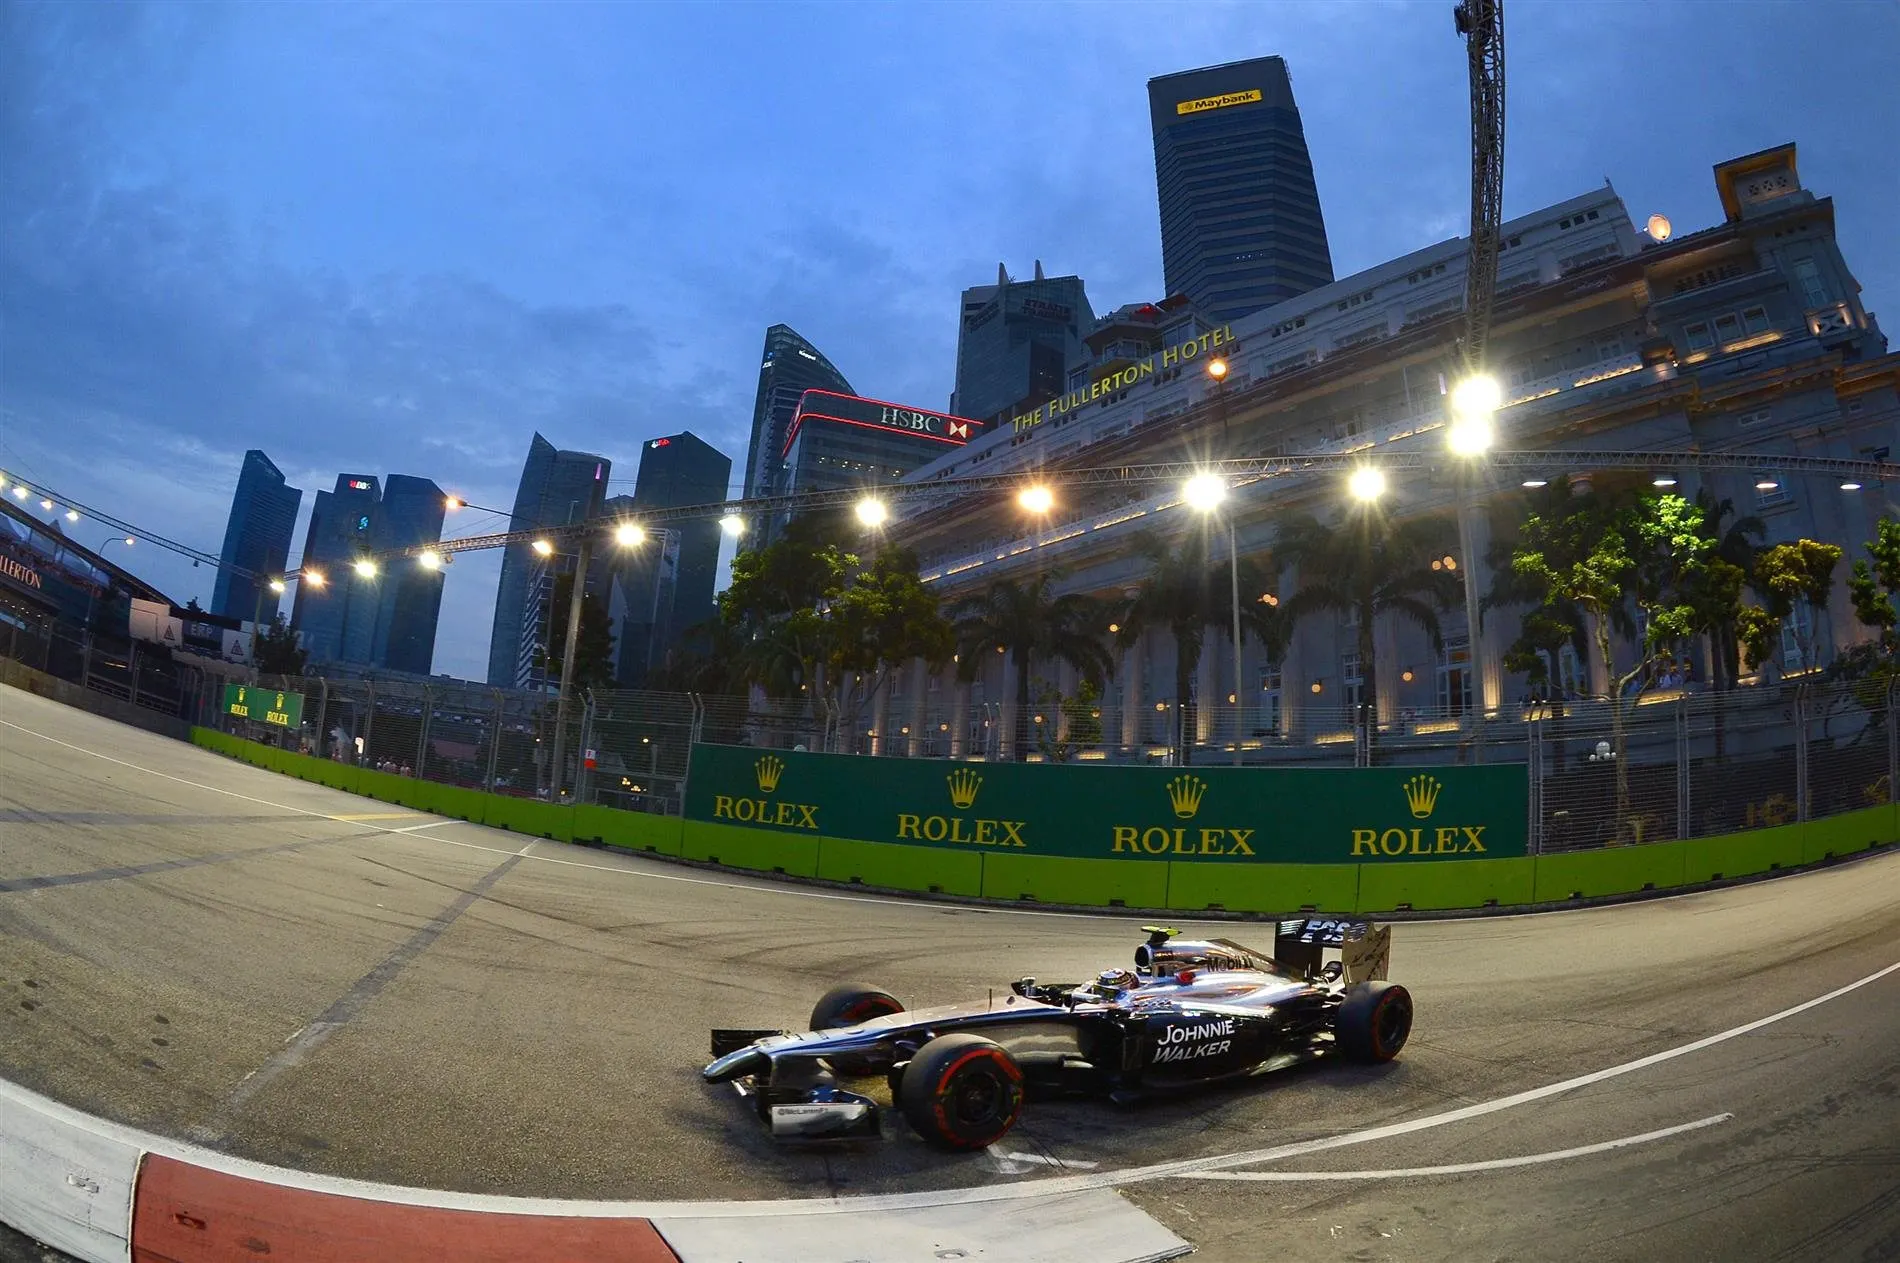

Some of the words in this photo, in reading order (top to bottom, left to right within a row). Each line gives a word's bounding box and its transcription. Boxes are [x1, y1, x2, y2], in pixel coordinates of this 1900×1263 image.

[1195, 93, 1254, 109] Maybank
[1012, 409, 1042, 433] THE
[1049, 359, 1153, 418] FULLERTON
[1162, 325, 1235, 369] HOTEL
[880, 407, 941, 433] HSBC
[266, 711, 289, 725] ROLEX
[713, 795, 819, 829] ROLEX
[896, 814, 1027, 848] ROLEX
[1111, 826, 1256, 856] ROLEX
[1350, 826, 1487, 856] ROLEX
[1157, 1020, 1236, 1045] JOHNNIE
[1152, 1040, 1231, 1063] WALKER
